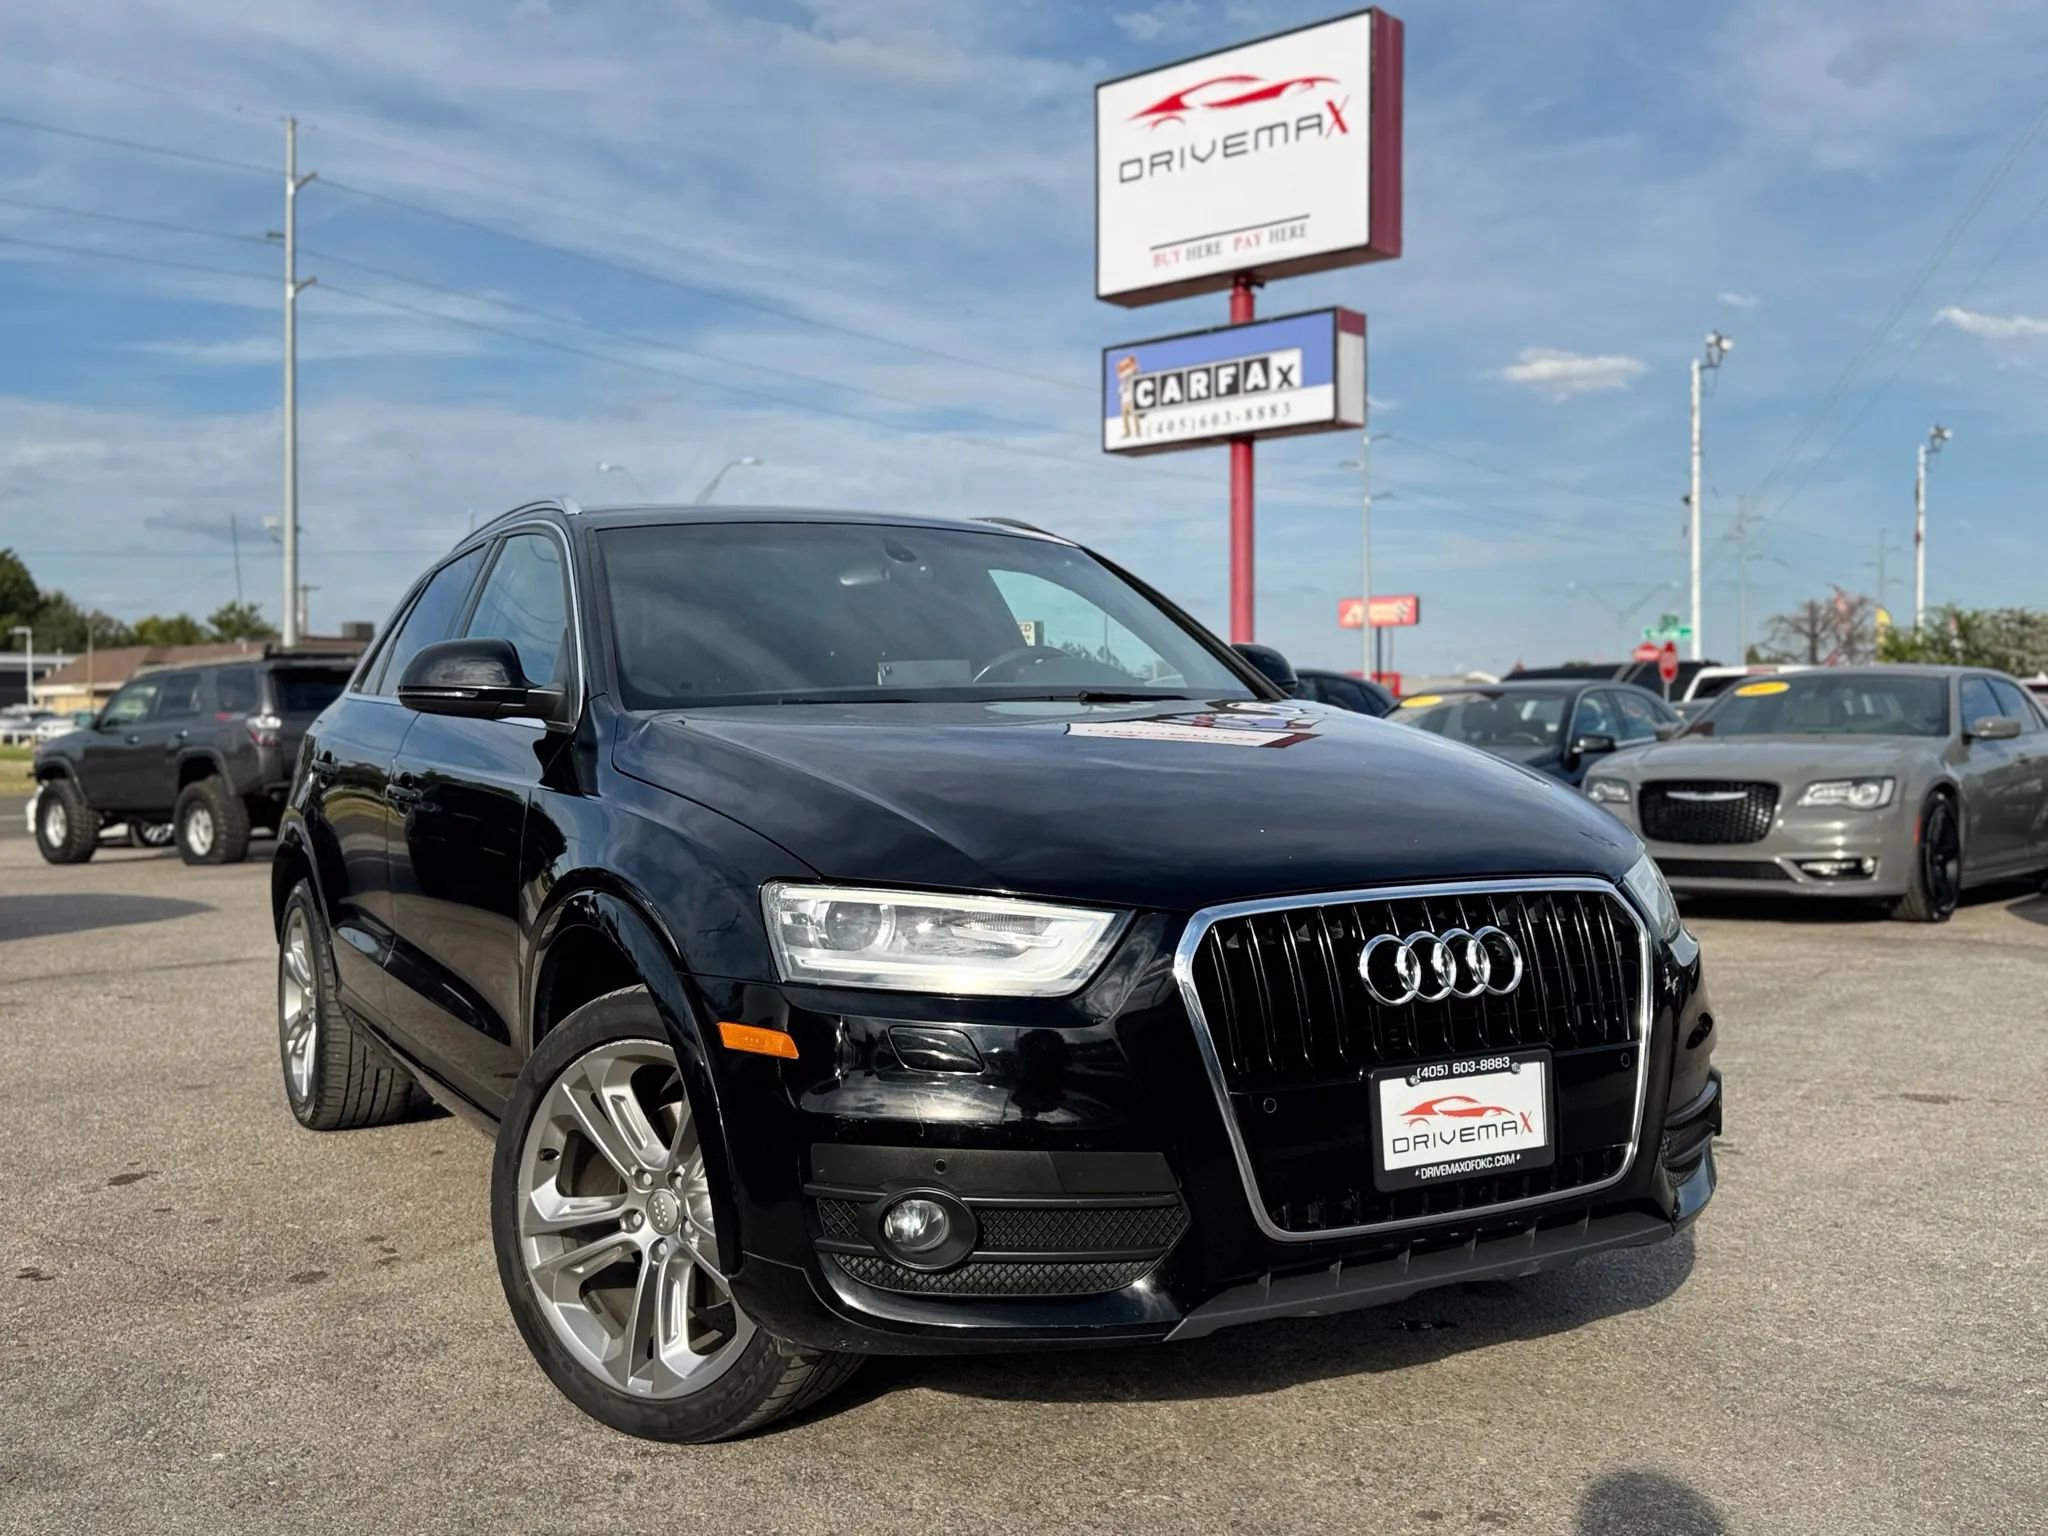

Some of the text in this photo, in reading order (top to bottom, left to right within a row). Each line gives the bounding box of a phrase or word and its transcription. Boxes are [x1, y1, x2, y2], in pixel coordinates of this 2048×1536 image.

[1119, 94, 1350, 184] DRIVEMAX
[1153, 223, 1307, 267] BUY HERE PAY HERE
[1134, 357, 1295, 410] CARFAX
[1416, 1056, 1511, 1079] (405) 603-8883
[1392, 1110, 1534, 1154] DRIVEMAX
[1421, 1153, 1516, 1179] DRIVEMAXOFOKC.COM
